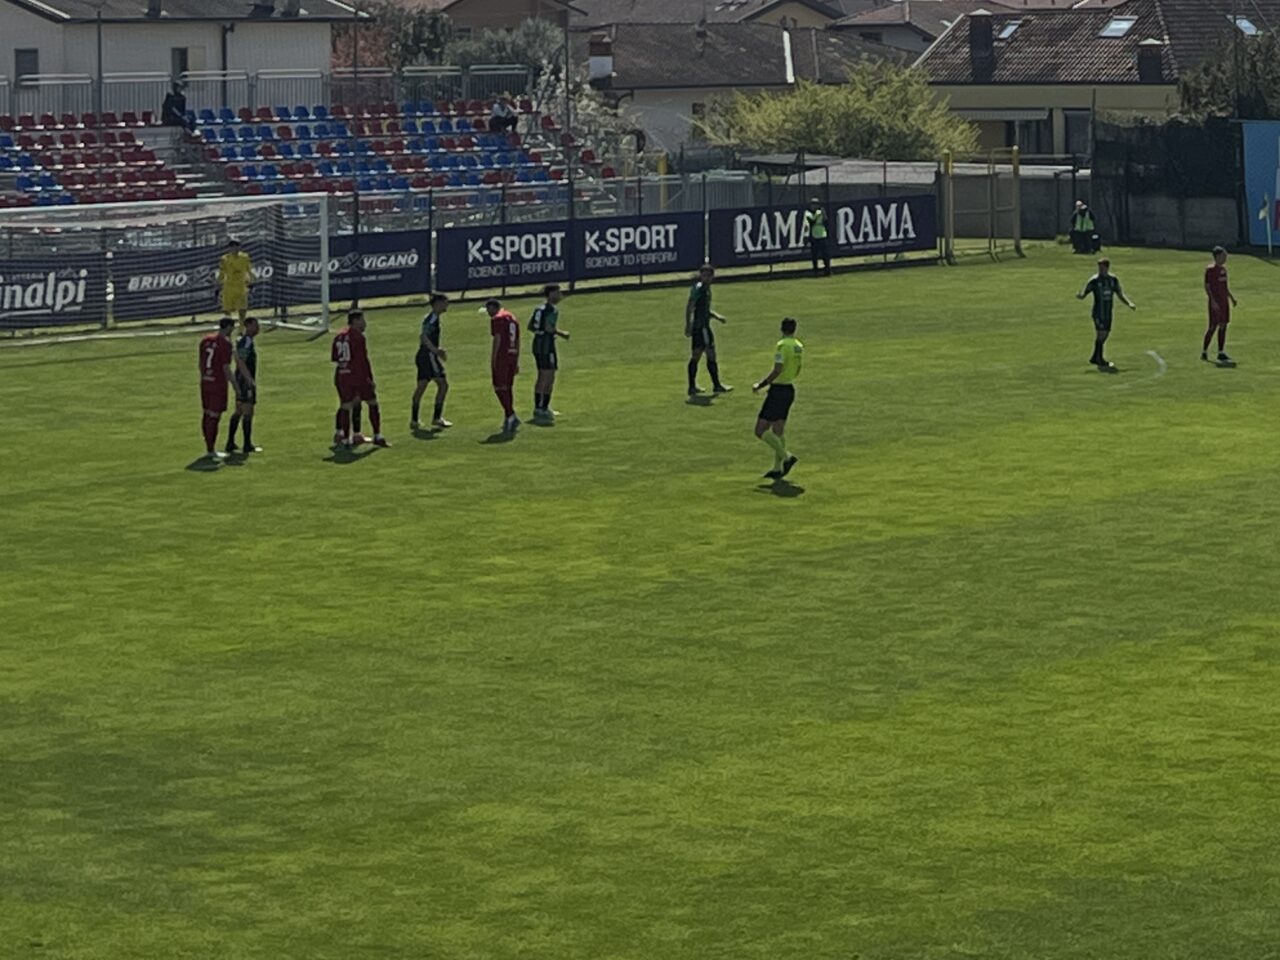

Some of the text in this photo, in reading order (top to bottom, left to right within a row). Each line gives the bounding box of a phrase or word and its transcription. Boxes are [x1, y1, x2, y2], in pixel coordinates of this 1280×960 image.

[734, 210, 812, 253] RAMA
[836, 201, 916, 245] RAMA
[467, 231, 565, 264] K-SPORT
[585, 224, 678, 254] K-SPORT
[287, 259, 339, 277] BRIVO
[468, 260, 564, 279] SCIENCE TO PERFORM
[585, 251, 678, 269] SCIENCE TO PERFORM
[0, 268, 88, 312] nalpi
[128, 273, 188, 292] BRIVIO
[205, 347, 214, 369] 7
